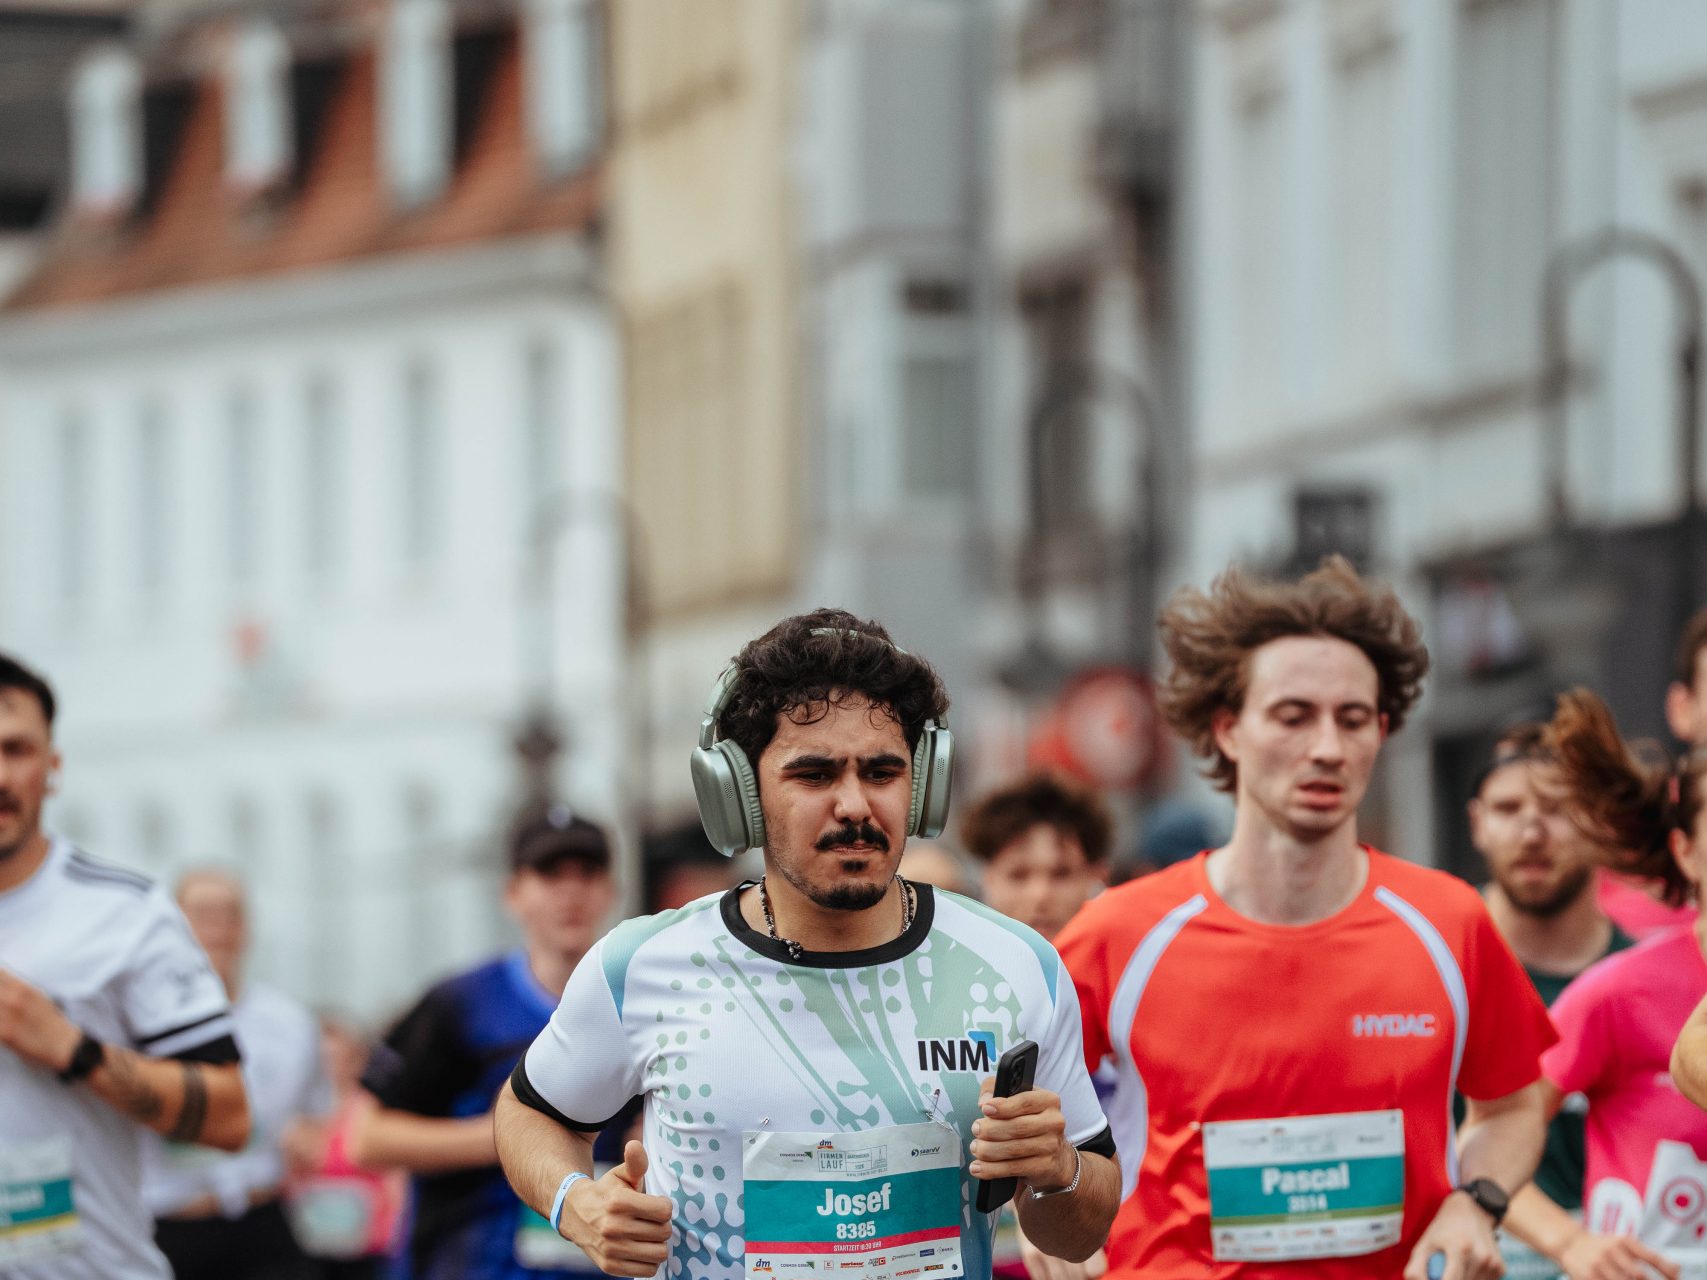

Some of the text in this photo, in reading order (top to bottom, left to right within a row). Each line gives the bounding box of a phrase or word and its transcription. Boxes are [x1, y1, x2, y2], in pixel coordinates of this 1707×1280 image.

[917, 1040, 990, 1072] INM
[821, 1160, 843, 1169] LAUF
[1261, 1162, 1350, 1195] Pascal
[816, 1182, 892, 1217] Josef
[836, 1220, 876, 1240] 8385
[833, 1244, 860, 1252] STARTZEIT
[755, 1258, 771, 1268] dm
